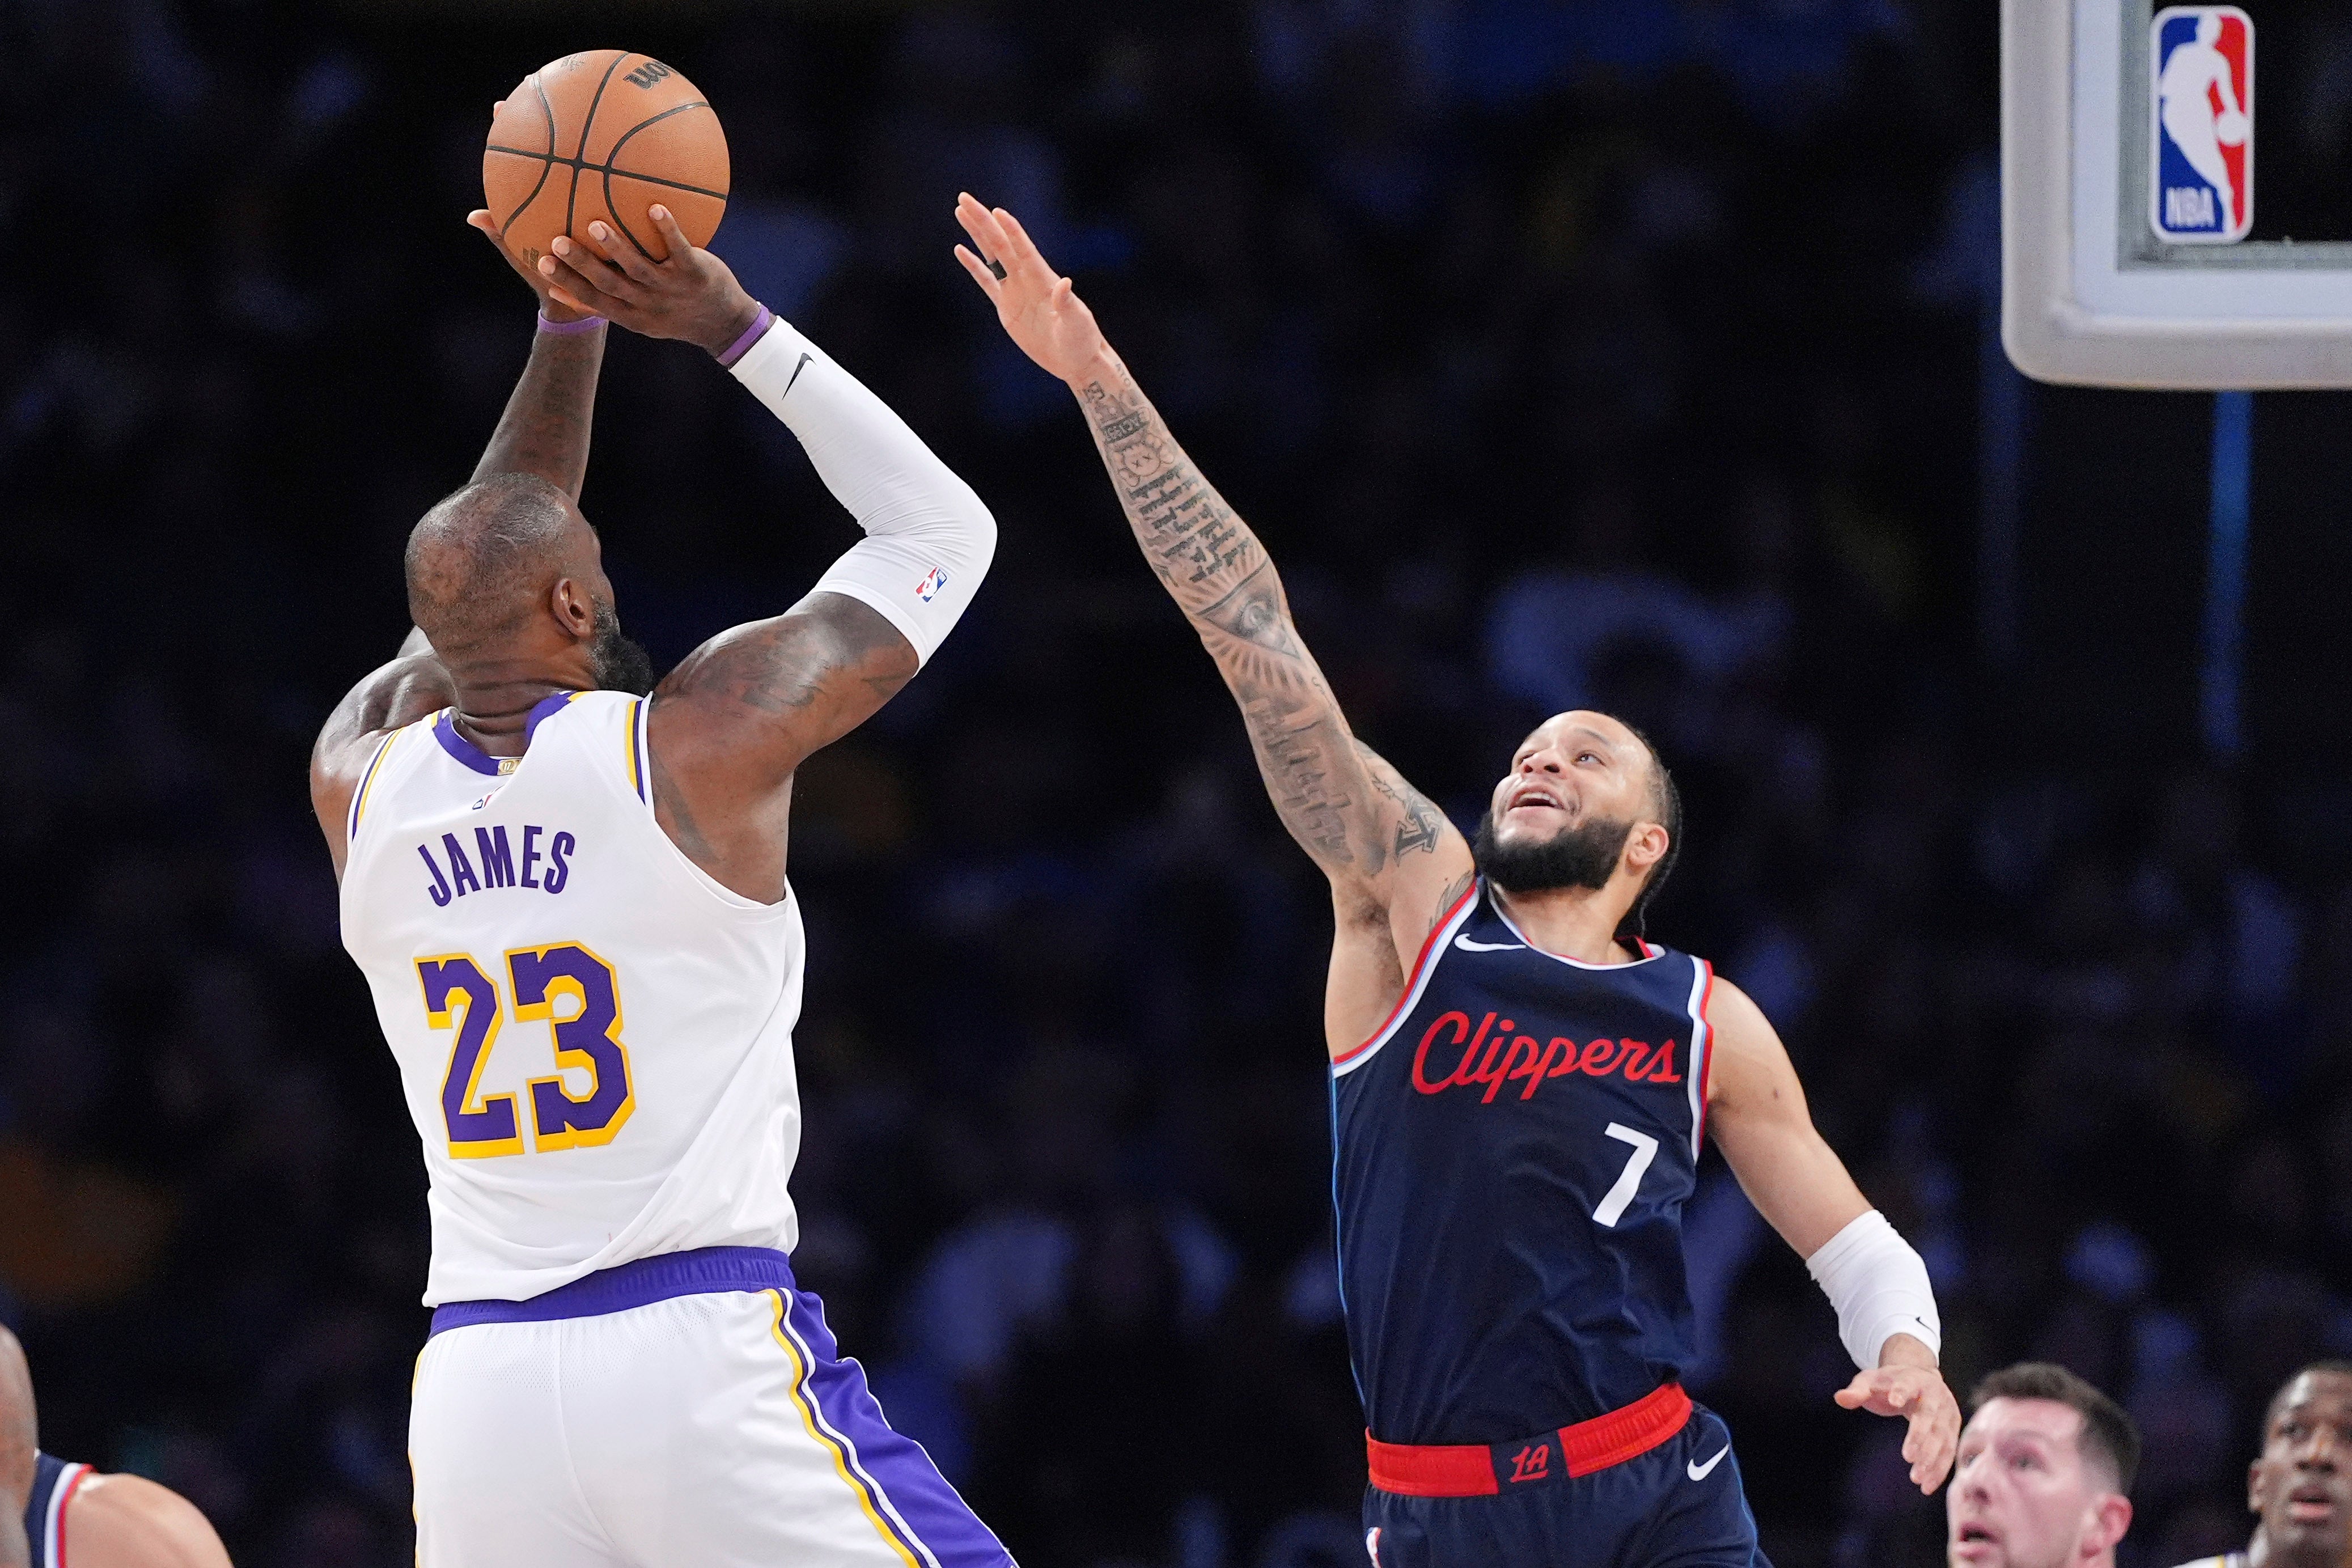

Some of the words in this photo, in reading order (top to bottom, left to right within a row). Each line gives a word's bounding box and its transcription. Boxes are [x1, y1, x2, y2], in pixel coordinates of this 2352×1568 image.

[2165, 187, 2215, 227] NBA
[417, 825, 575, 907] JAMES
[413, 940, 636, 1159] 23
[1412, 1011, 1681, 1104] Clippers
[1592, 1122, 1659, 1228] 7
